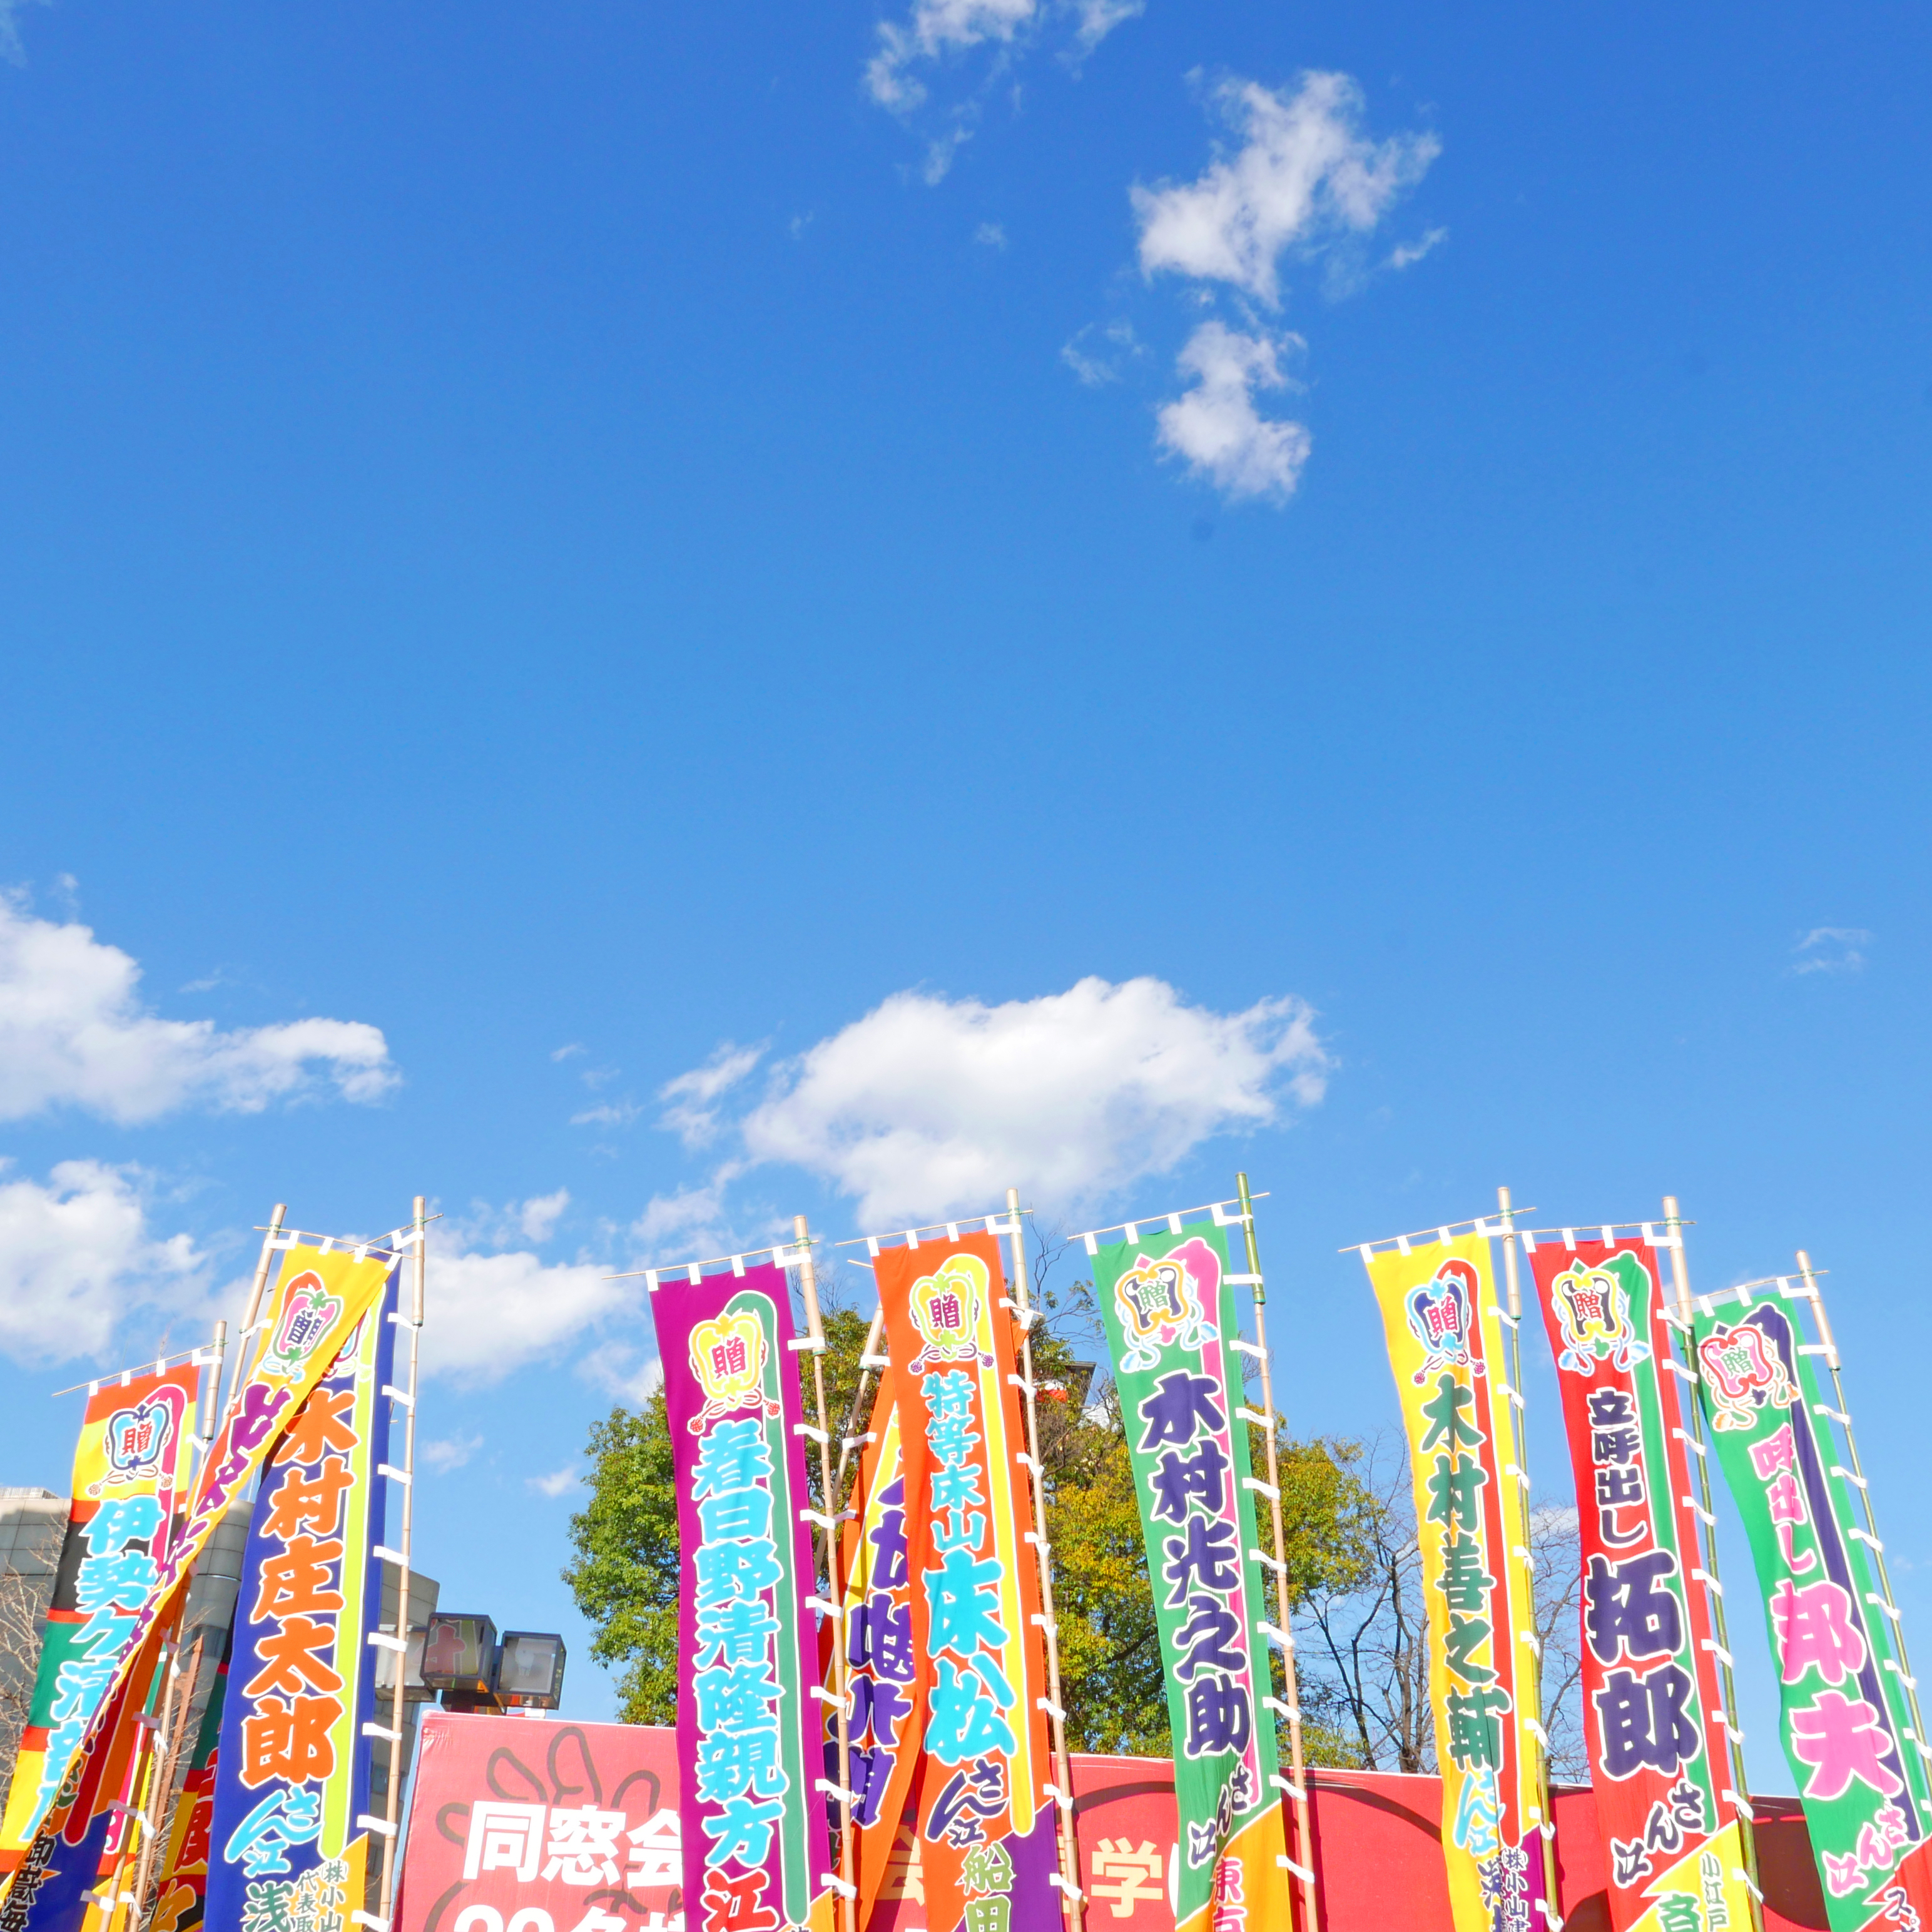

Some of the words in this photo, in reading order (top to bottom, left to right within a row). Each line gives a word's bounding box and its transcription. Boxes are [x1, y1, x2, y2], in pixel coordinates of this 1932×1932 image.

[929, 1294, 960, 1330] 贈
[1139, 1281, 1168, 1314] 贈
[1427, 1296, 1458, 1337] 贈
[1573, 1291, 1602, 1320] 贈
[711, 1336, 746, 1376] 贈
[463, 1800, 684, 1887] 同窓会
